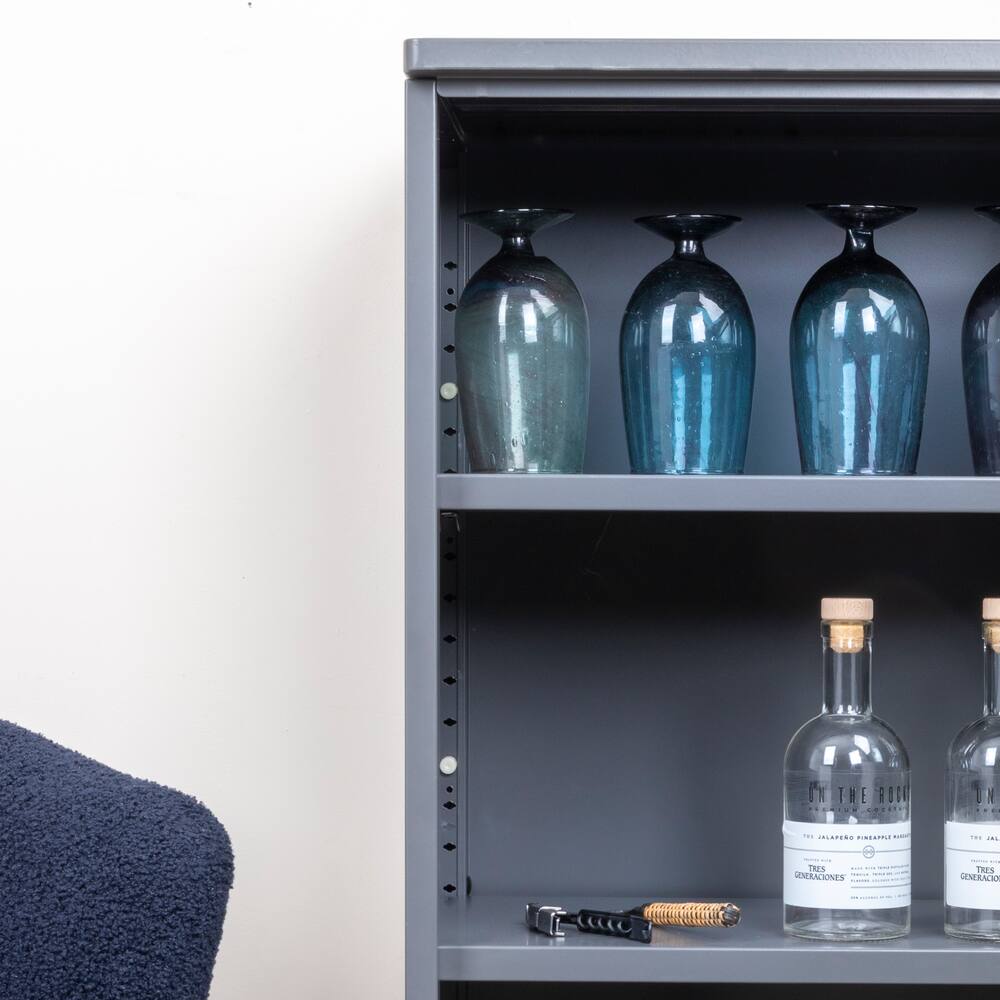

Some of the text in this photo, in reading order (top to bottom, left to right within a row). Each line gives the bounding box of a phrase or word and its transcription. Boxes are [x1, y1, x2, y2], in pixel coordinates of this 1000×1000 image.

[838, 786, 867, 804] THE
[808, 864, 826, 873] TRES
[976, 866, 995, 874] TRES
[794, 871, 845, 882] GENERACIONES
